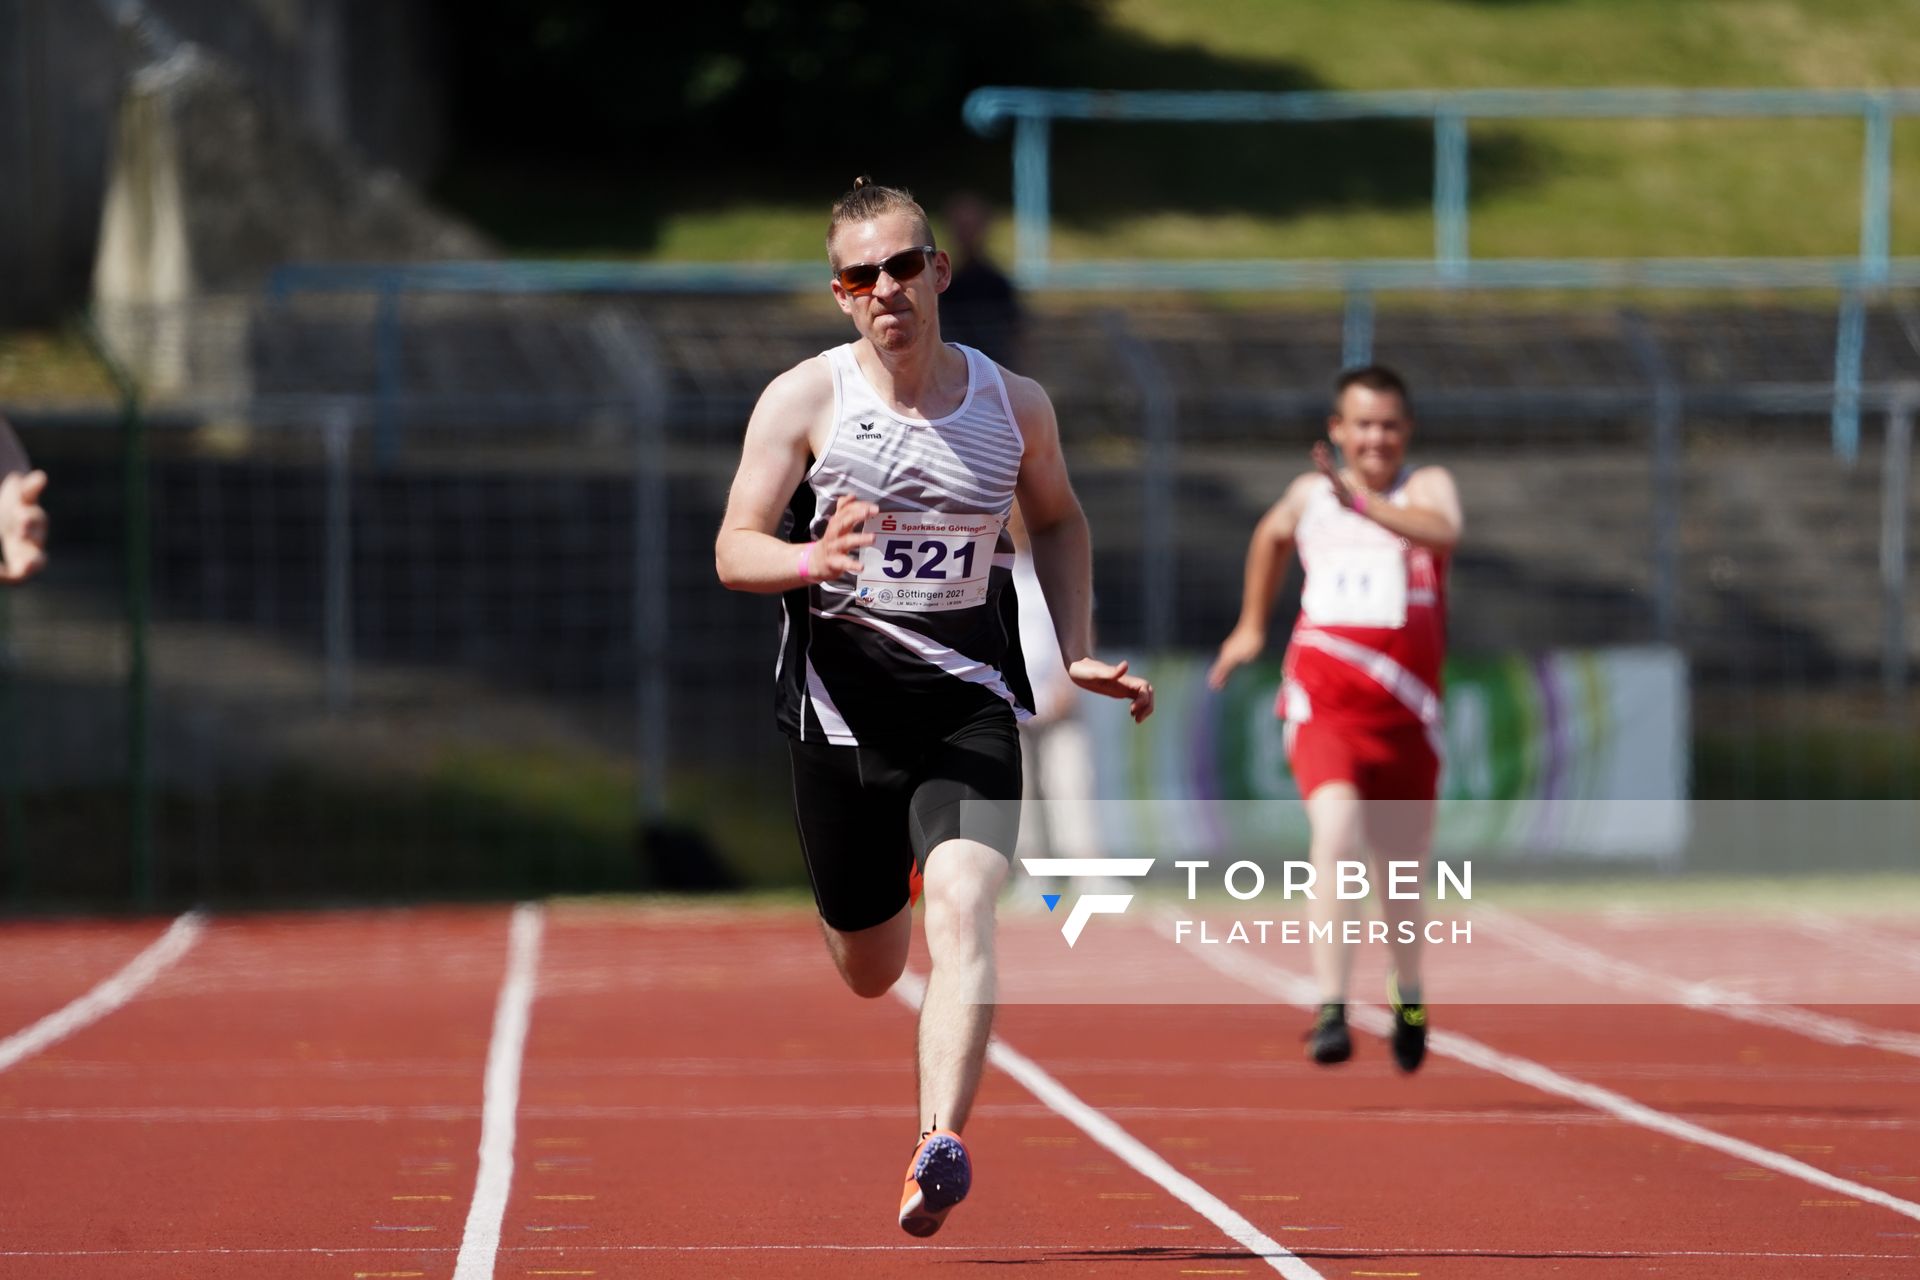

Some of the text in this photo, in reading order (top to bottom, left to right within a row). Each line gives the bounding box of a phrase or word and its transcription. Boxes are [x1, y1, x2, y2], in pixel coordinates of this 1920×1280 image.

[901, 523, 946, 532] Sparkasse
[948, 525, 987, 533] Göttingen
[882, 540, 976, 579] 521
[897, 589, 965, 600] Göttingen 2021
